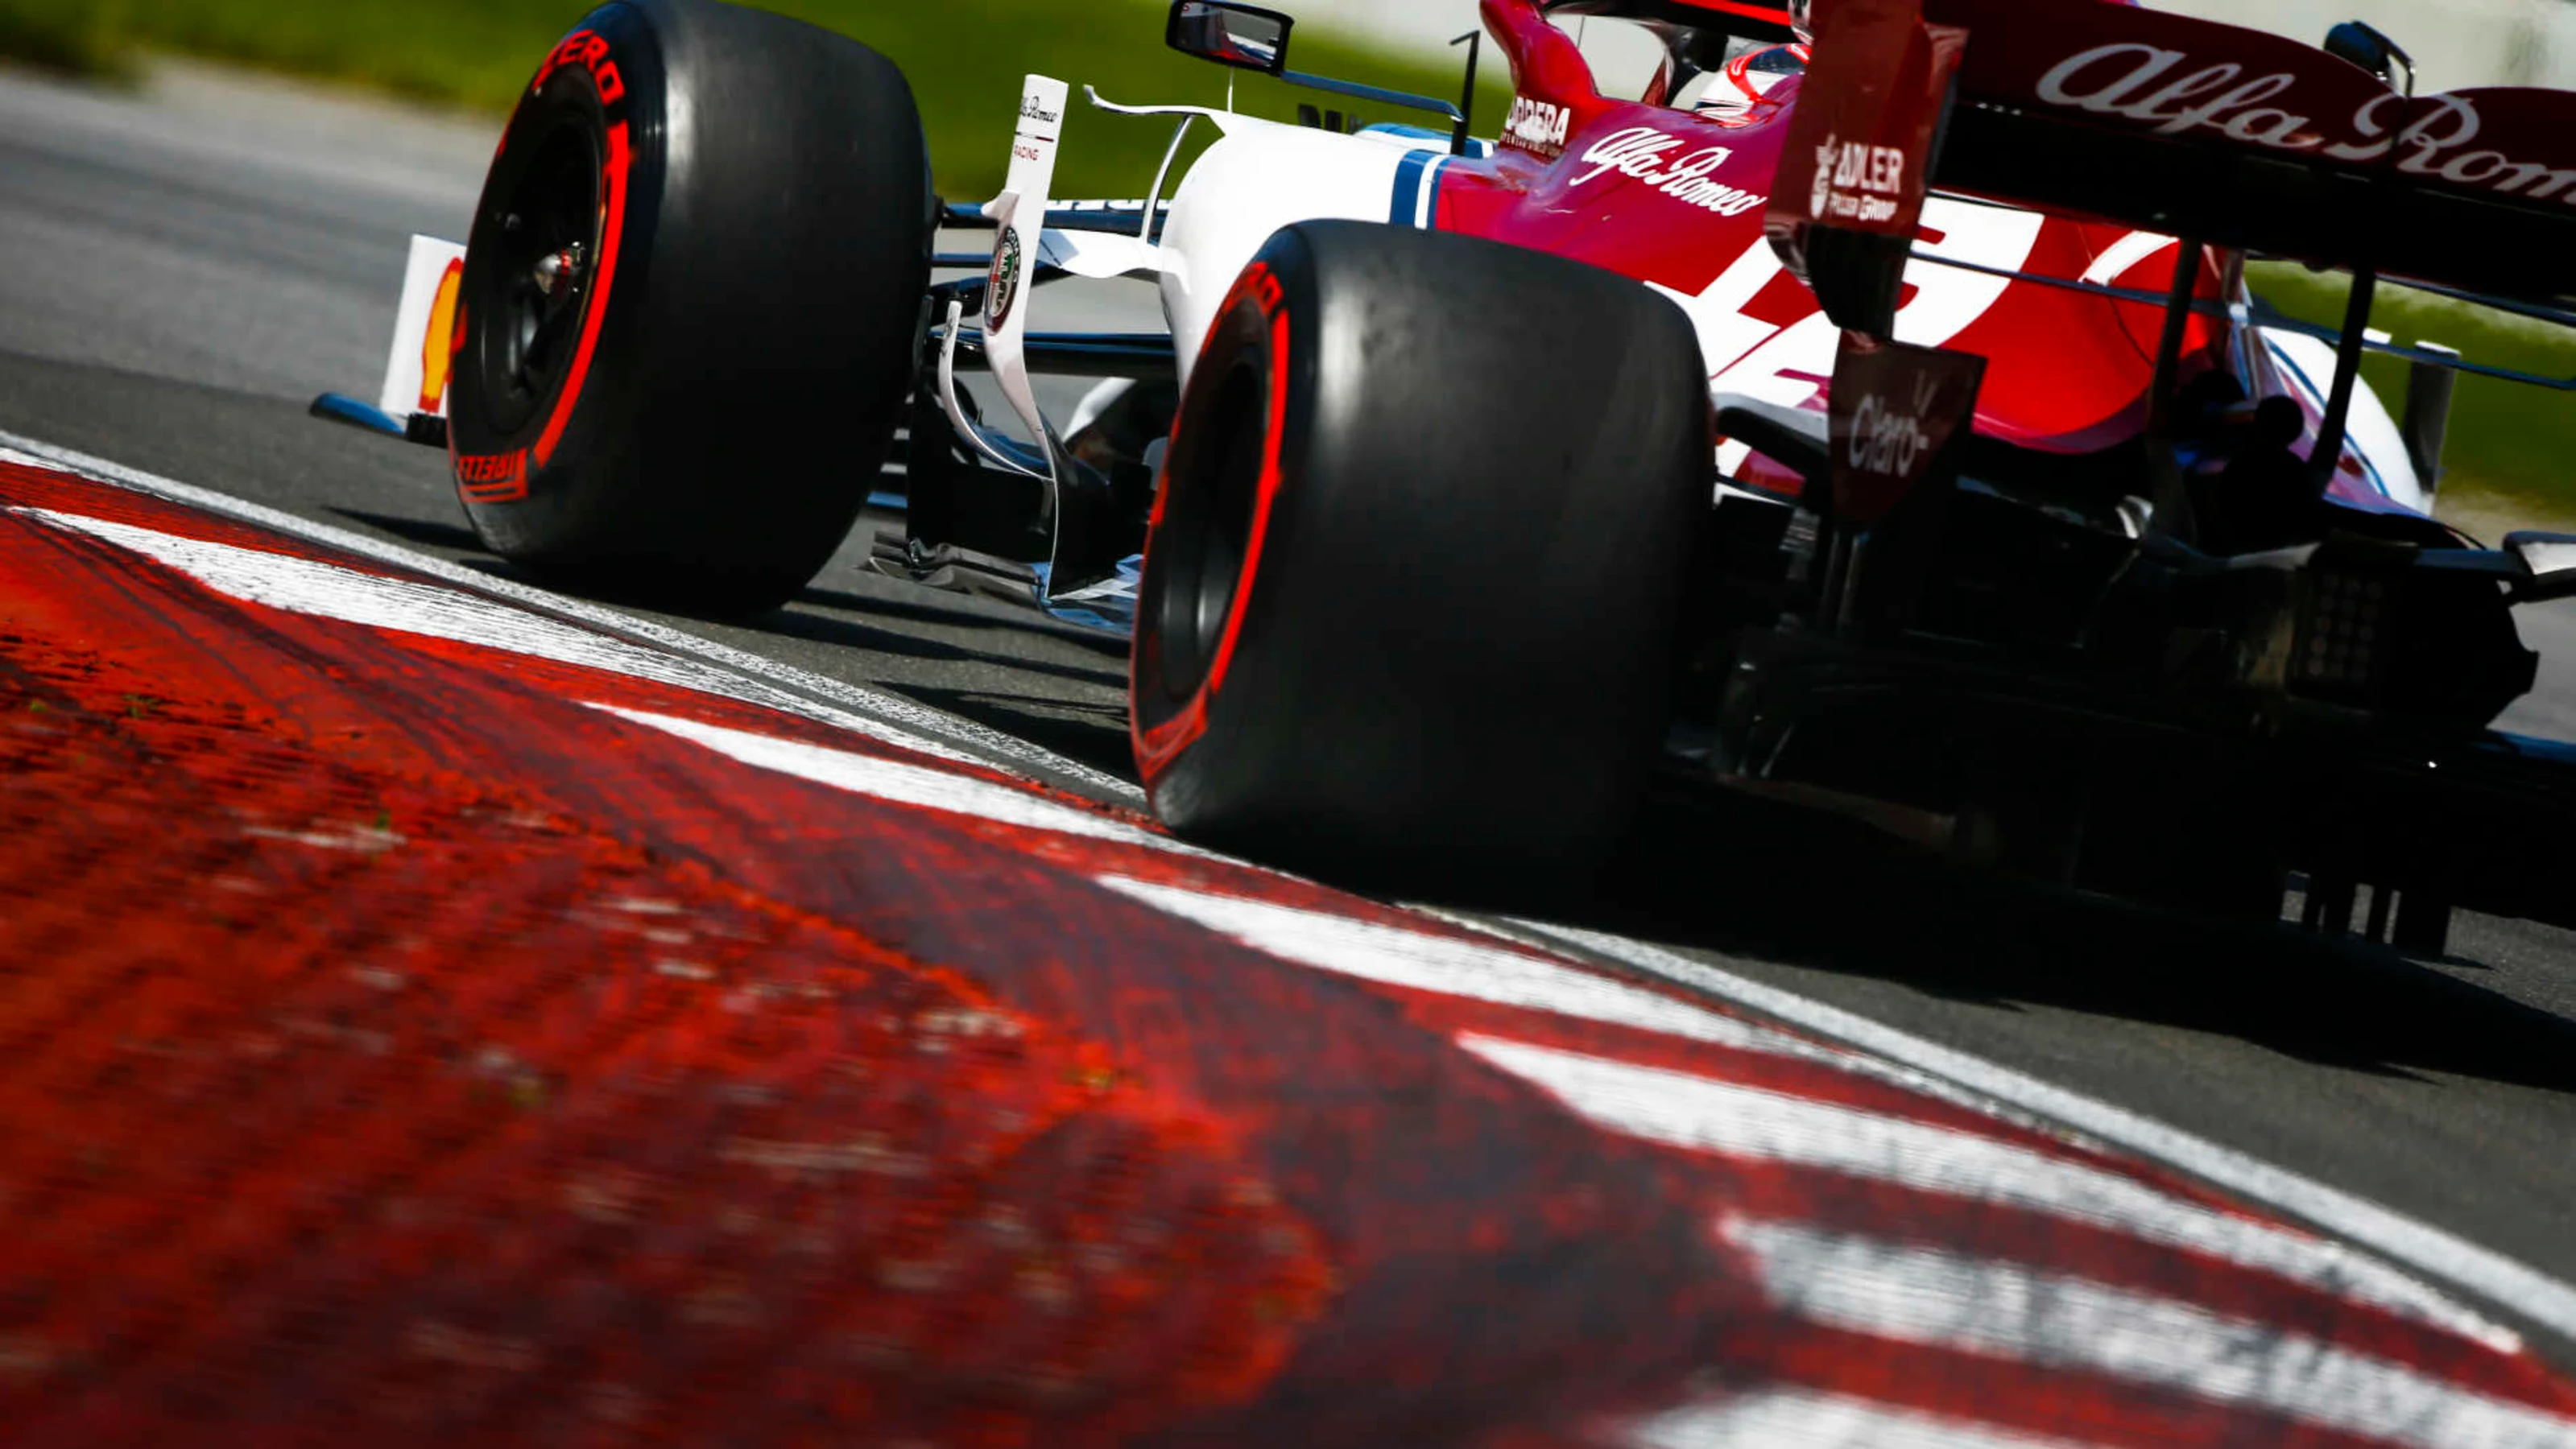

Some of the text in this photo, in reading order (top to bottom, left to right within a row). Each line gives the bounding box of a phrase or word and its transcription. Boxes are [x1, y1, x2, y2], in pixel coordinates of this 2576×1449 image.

[2035, 43, 2325, 148] Alfa
[1569, 126, 1685, 187] Alfa
[1644, 146, 1768, 217] Romeo
[1834, 142, 1904, 195] ADLER
[1850, 394, 1919, 478] Claro
